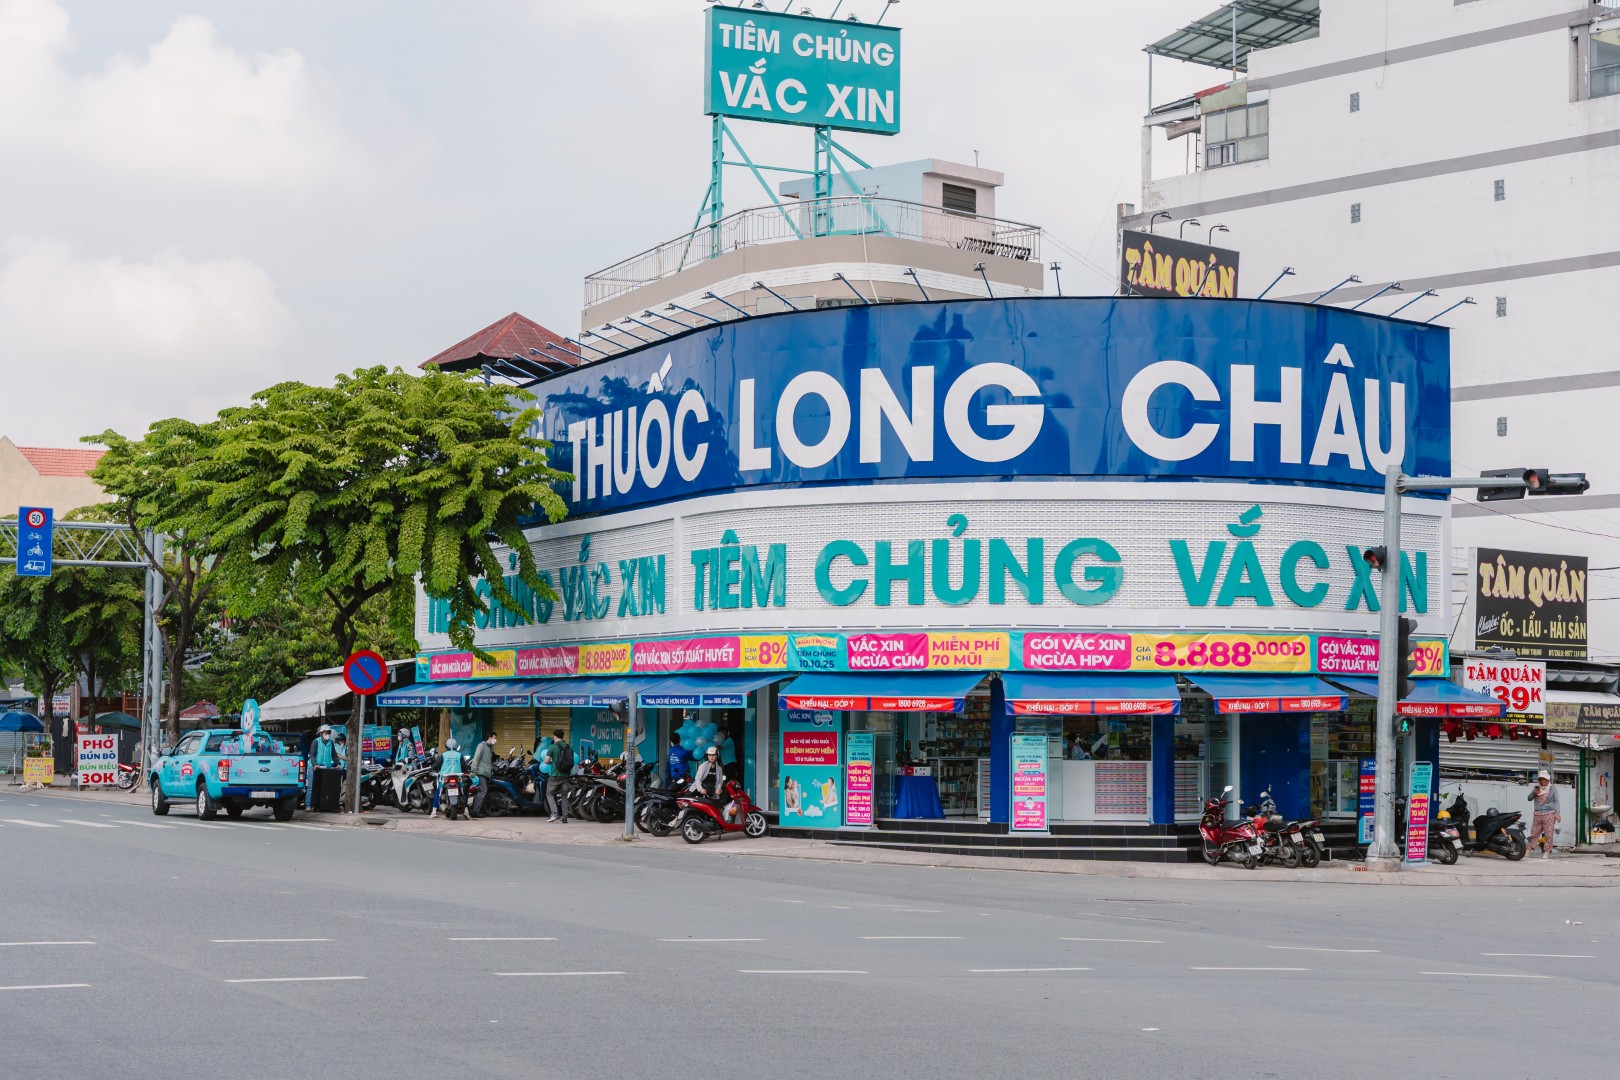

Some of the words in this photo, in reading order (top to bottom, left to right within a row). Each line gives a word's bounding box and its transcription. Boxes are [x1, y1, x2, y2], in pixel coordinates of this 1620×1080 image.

[719, 20, 780, 54] TIÊM
[793, 29, 895, 67] CHỦNG
[718, 57, 808, 114] VẮC
[825, 83, 894, 124] XIN
[1126, 240, 1173, 292] TÂM
[568, 352, 710, 502] THUỐC
[739, 362, 1045, 470] LONG
[1121, 343, 1405, 476] CHÂU
[31, 514, 41, 524] 50
[690, 529, 787, 611] TIÊM
[814, 513, 1124, 606] CHỦNG
[1169, 504, 1330, 607] VẮC
[1345, 545, 1428, 614] XN
[559, 535, 611, 621] VẮC
[617, 554, 665, 618] XIN
[1479, 554, 1525, 600] TÂM
[1500, 611, 1514, 636] ỐC
[1522, 610, 1541, 638] LẨU
[1550, 614, 1566, 639] HẢI
[1568, 615, 1587, 640] SẢN
[849, 637, 878, 652] VẮC
[880, 640, 904, 652] XIN
[932, 636, 973, 651] MIỄN
[975, 638, 1000, 651] PHÍ
[1030, 636, 1059, 651] GÓI
[1062, 635, 1097, 651] VẮC
[1099, 639, 1126, 651] XIN
[1321, 640, 1339, 655] GÓI
[1340, 640, 1359, 655] VẮC
[1360, 644, 1376, 656] XIN
[635, 649, 647, 665] GÓI
[647, 647, 660, 665] VẮC
[660, 651, 671, 665] XIN
[672, 646, 685, 664] SỐT
[685, 645, 705, 663] XUẤT
[705, 643, 735, 662] HUYẾT
[758, 641, 787, 665] 8%
[851, 652, 890, 668] NGỪA
[892, 653, 925, 668] CÚM
[932, 655, 950, 666] 70
[953, 652, 982, 666] MŨI
[1030, 652, 1077, 667] NGỪA
[1080, 654, 1114, 667] HPV
[1414, 647, 1442, 672] 8%
[799, 659, 835, 668] 10.10.25
[1321, 655, 1341, 670] SỐT
[1341, 656, 1366, 671] XUẤT
[1467, 662, 1498, 681] TÂM
[1500, 664, 1543, 685] QUÁN
[800, 698, 816, 708] KHIẾU
[817, 700, 829, 710] NẠI
[834, 699, 849, 708] GÓP
[849, 699, 854, 707] Ý
[1026, 703, 1043, 712] KHIẾU
[1059, 704, 1074, 712] GÓP
[1120, 702, 1132, 710] 1800
[1133, 702, 1147, 710] 6928
[83, 735, 114, 750] PHỞ
[80, 751, 100, 760] BÚN
[103, 750, 116, 760] BÒ
[80, 763, 97, 771] BÚN
[98, 762, 117, 770] RIÊU
[82, 773, 114, 784] 30K
